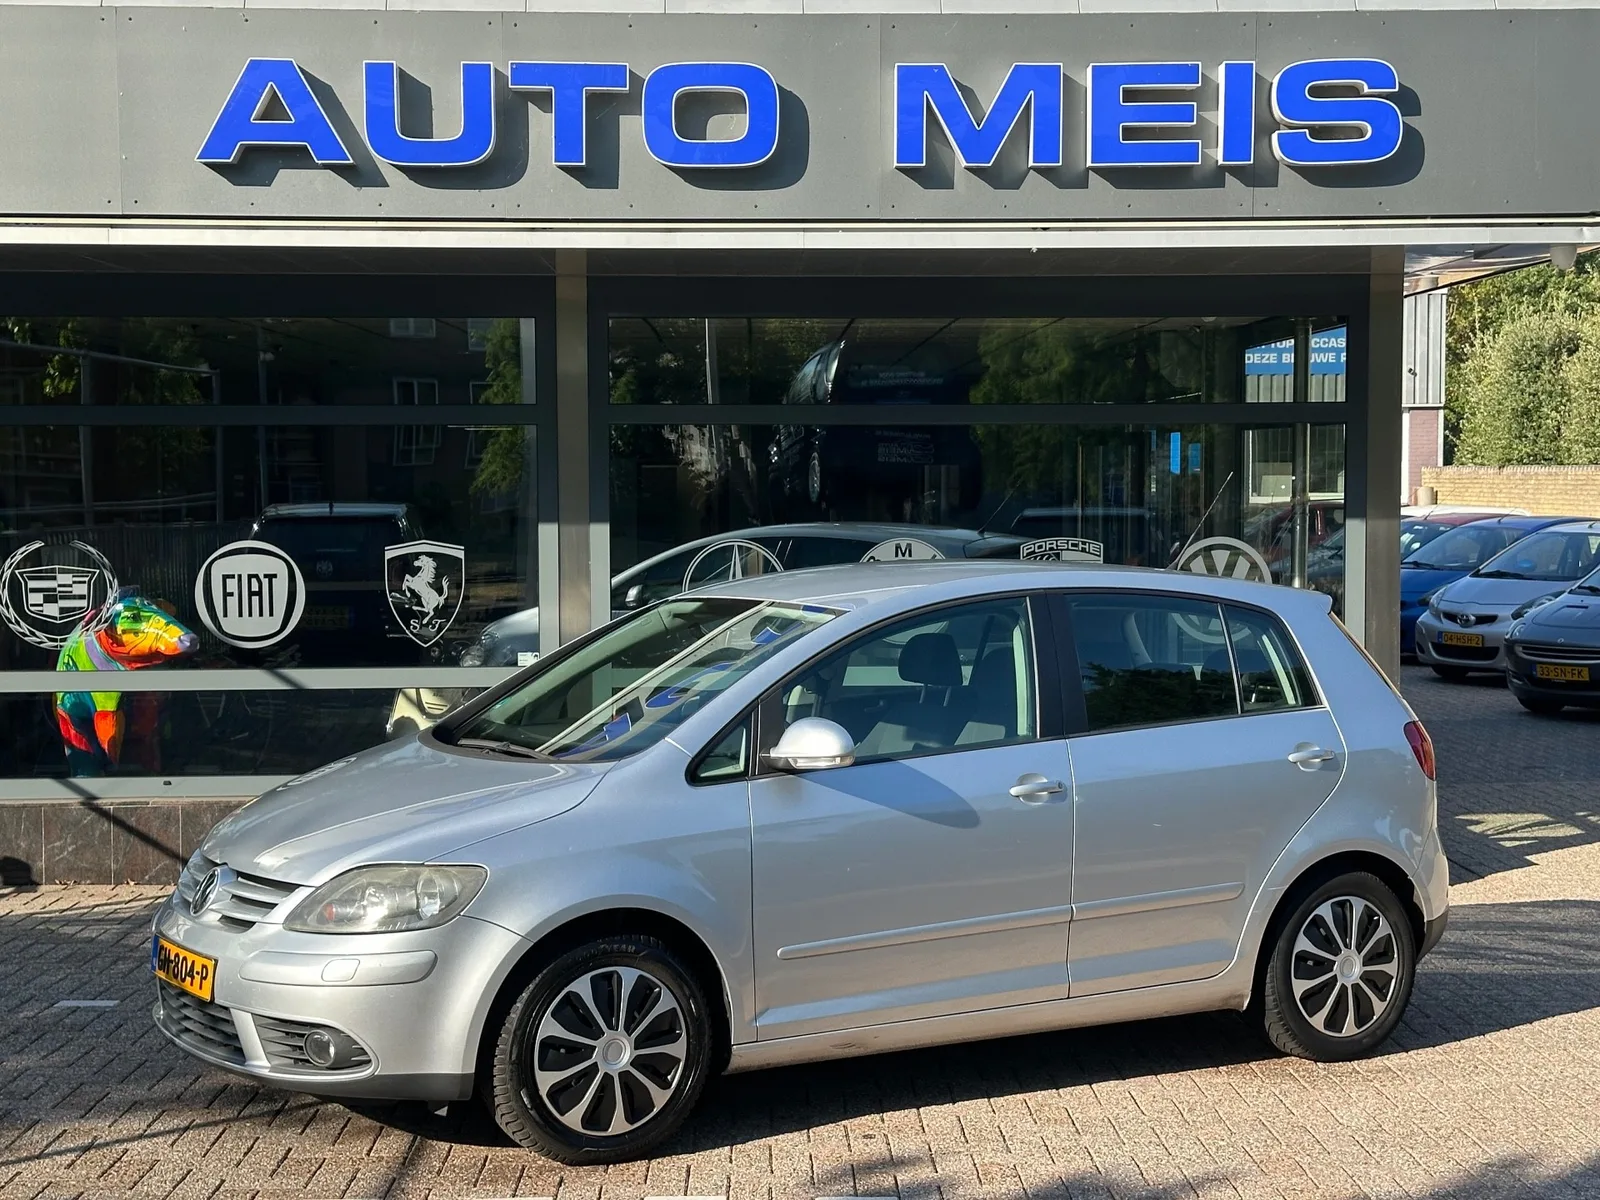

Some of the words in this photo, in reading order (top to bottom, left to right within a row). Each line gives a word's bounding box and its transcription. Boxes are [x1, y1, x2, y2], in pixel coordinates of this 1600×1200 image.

[194, 57, 780, 168] AUTO
[894, 57, 1403, 168] MEIS
[1245, 353, 1277, 363] DEZE
[1023, 540, 1100, 556] PORSCHE
[221, 573, 278, 618] FIAT
[1443, 633, 1480, 646] 04-HSH-2
[1539, 666, 1584, 679] 33-SN-FK
